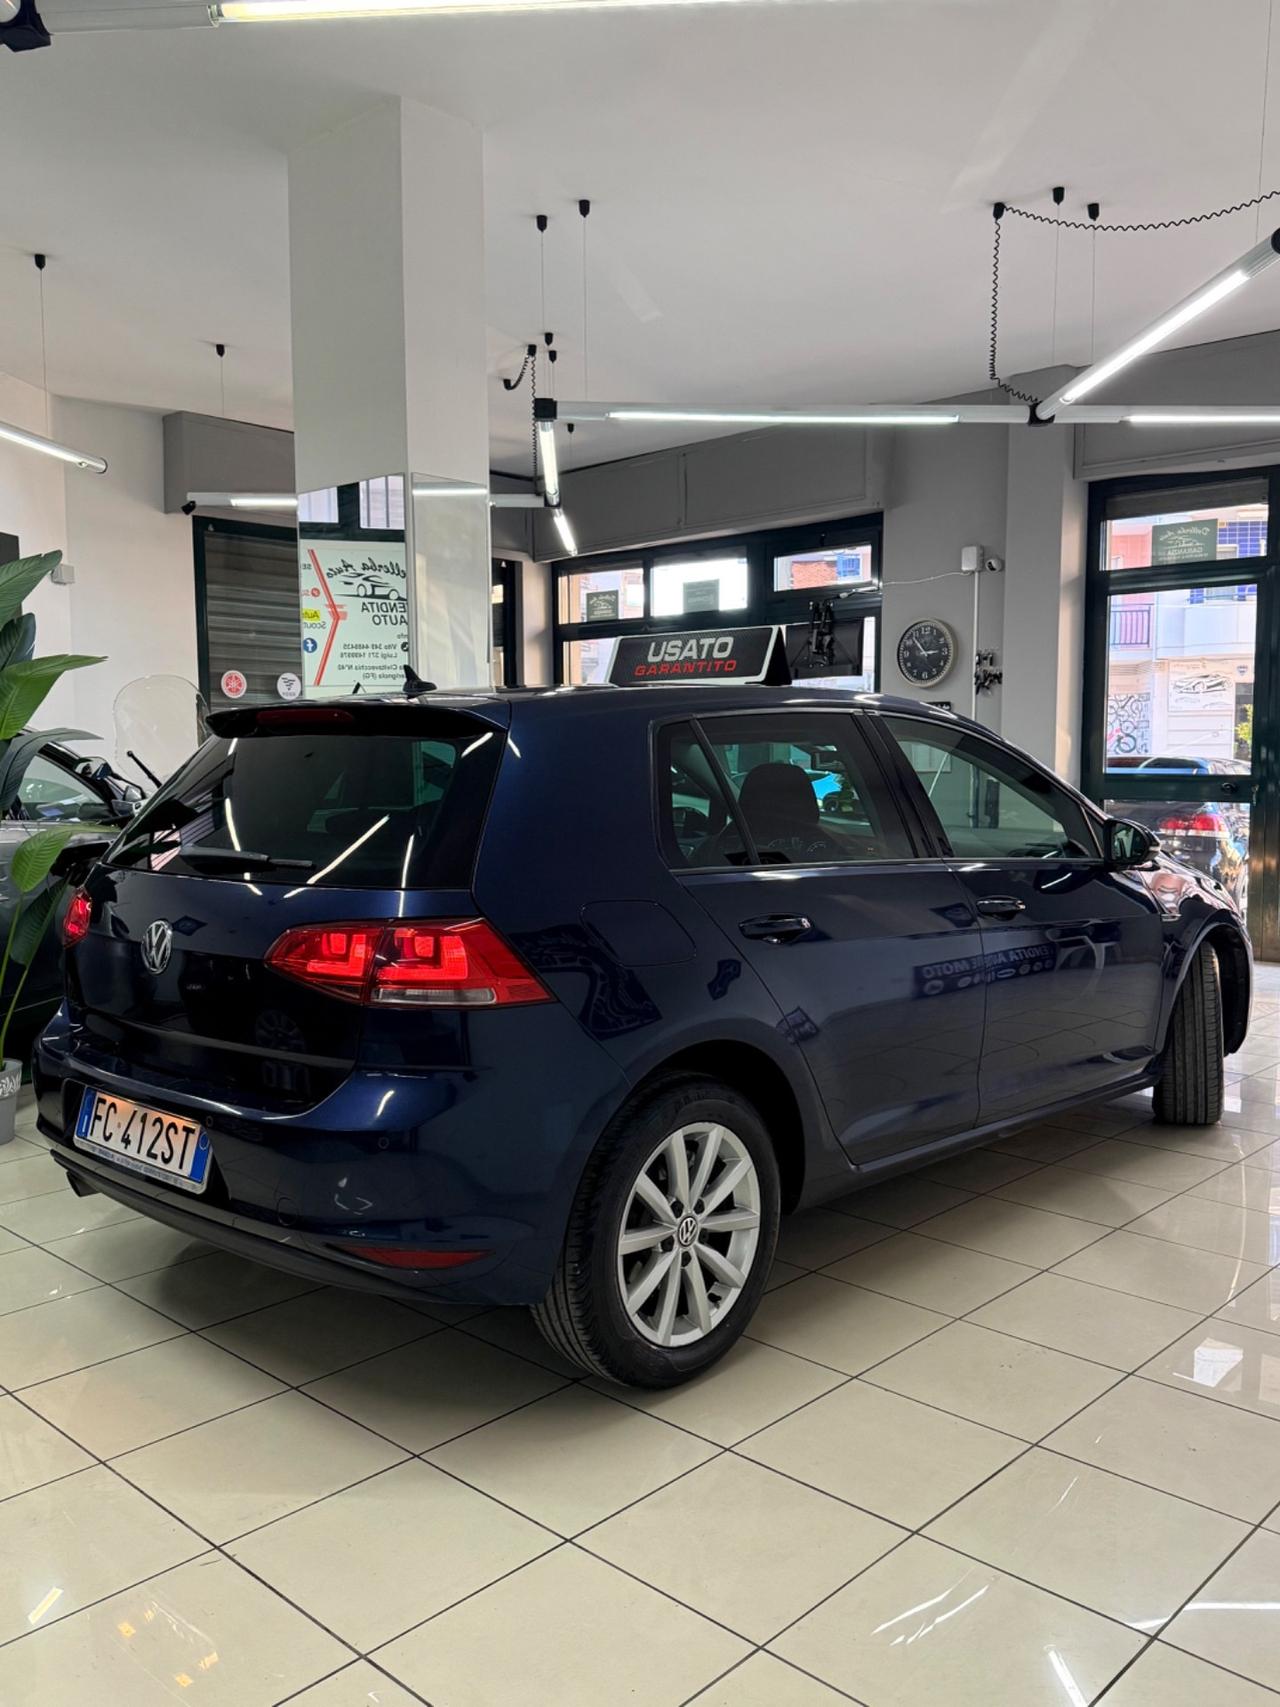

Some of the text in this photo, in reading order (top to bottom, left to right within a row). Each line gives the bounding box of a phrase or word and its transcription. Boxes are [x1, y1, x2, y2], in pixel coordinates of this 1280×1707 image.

[647, 636, 734, 663] USATO
[634, 660, 737, 677] GARANTITO
[89, 1097, 118, 1142] FC
[120, 1109, 196, 1170] 412ST
